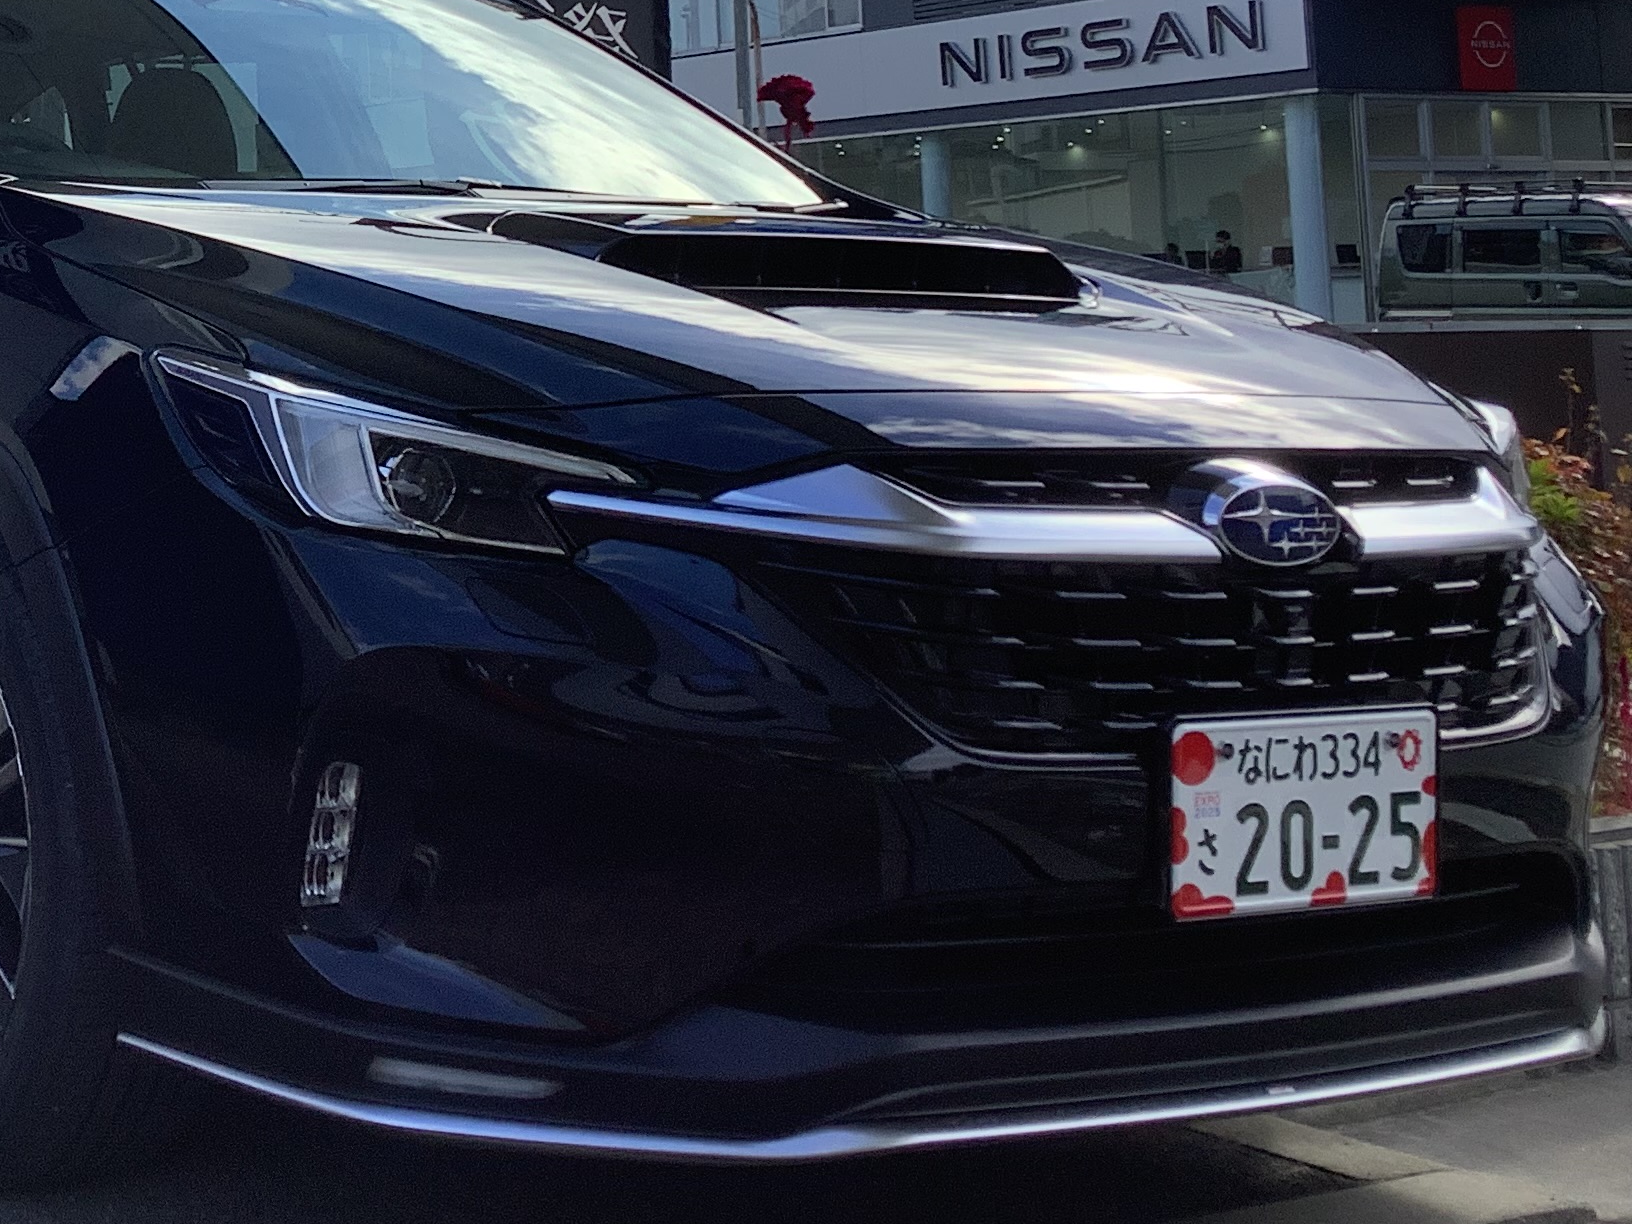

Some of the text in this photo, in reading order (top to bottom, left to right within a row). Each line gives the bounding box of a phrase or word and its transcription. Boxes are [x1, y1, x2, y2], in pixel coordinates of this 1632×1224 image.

[939, 0, 1266, 88] NISSAN
[1471, 39, 1511, 49] NISSAN
[1197, 790, 1422, 897] さ 20-25
